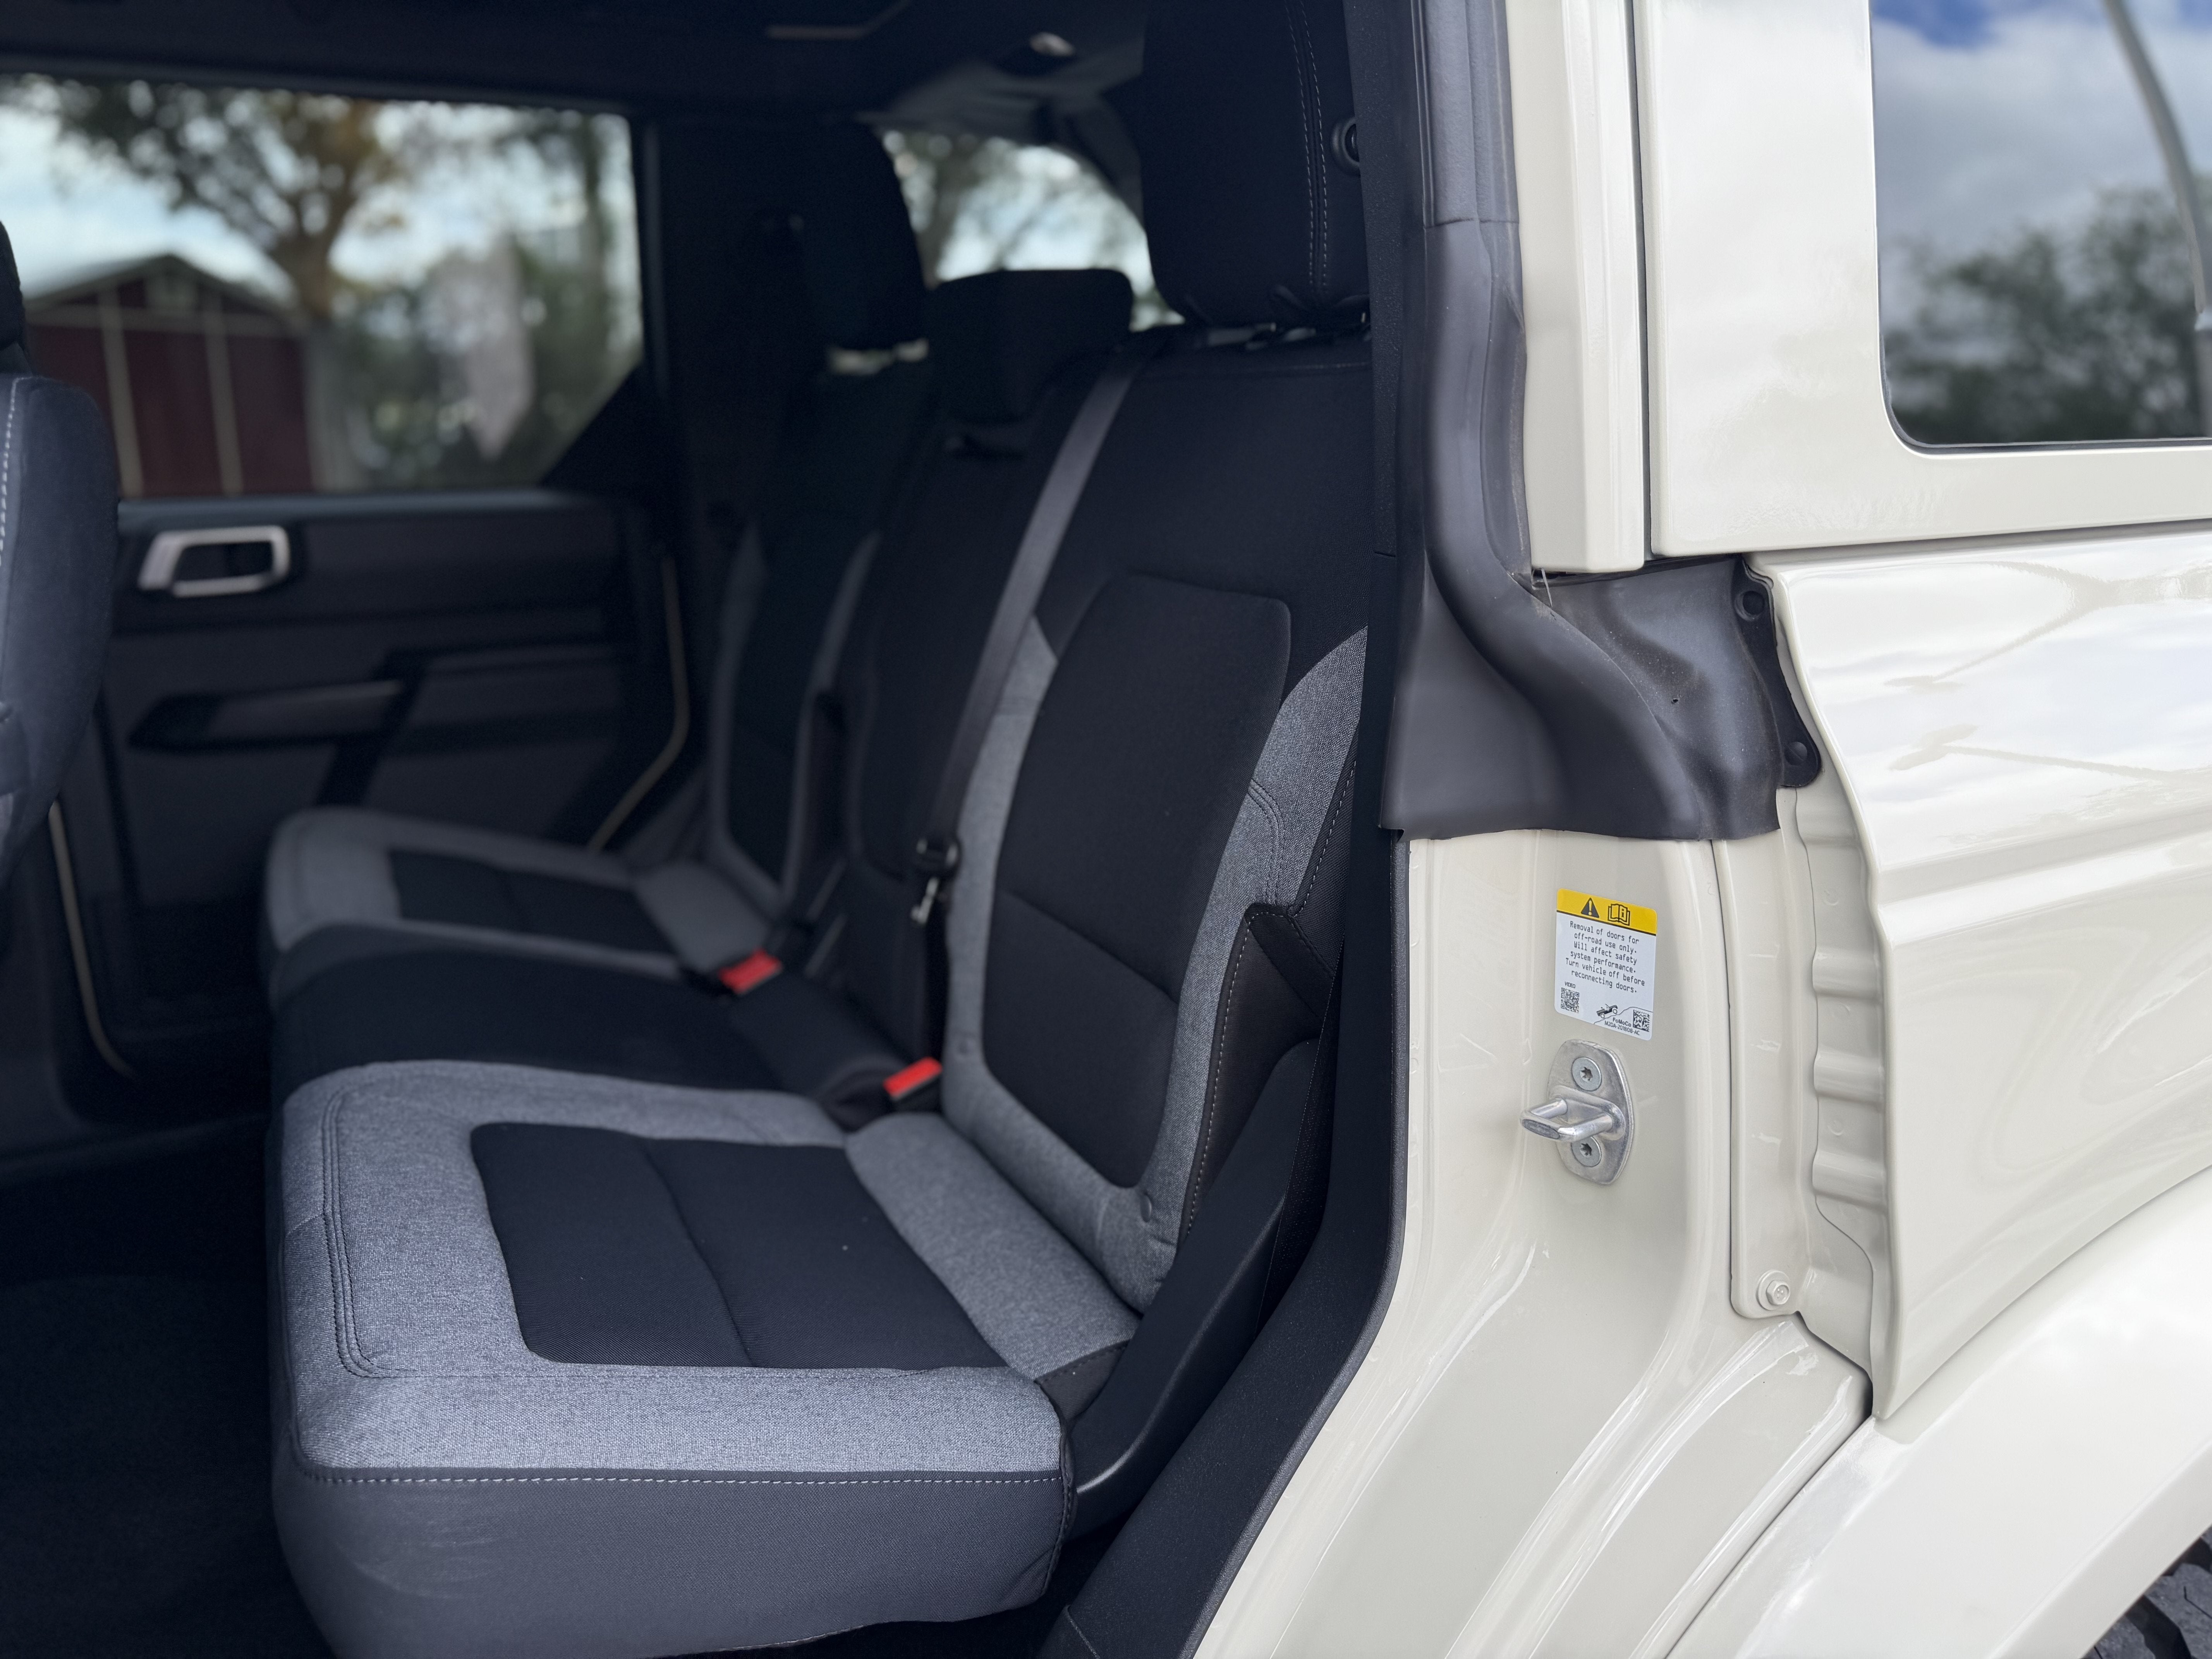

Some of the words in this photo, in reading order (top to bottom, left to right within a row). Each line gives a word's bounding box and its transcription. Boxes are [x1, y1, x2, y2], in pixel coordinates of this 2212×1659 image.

[1570, 921, 1593, 933] Removal
[1607, 931, 1625, 941] doors
[1629, 936, 1639, 944] for
[1574, 932, 1602, 945] off-road
[1620, 945, 1636, 955] only.
[1570, 951, 1590, 961] system
[1594, 957, 1635, 973] performance.
[1574, 941, 1587, 951] Will
[1591, 946, 1611, 957] affect
[1616, 953, 1637, 965] safety
[1566, 958, 1578, 967] Turn
[1582, 964, 1606, 975] vehicle
[1623, 973, 1645, 986] before
[1571, 970, 1613, 988] reconnecting
[1616, 982, 1637, 993] doors.
[1613, 1017, 1632, 1027] FoMoCo
